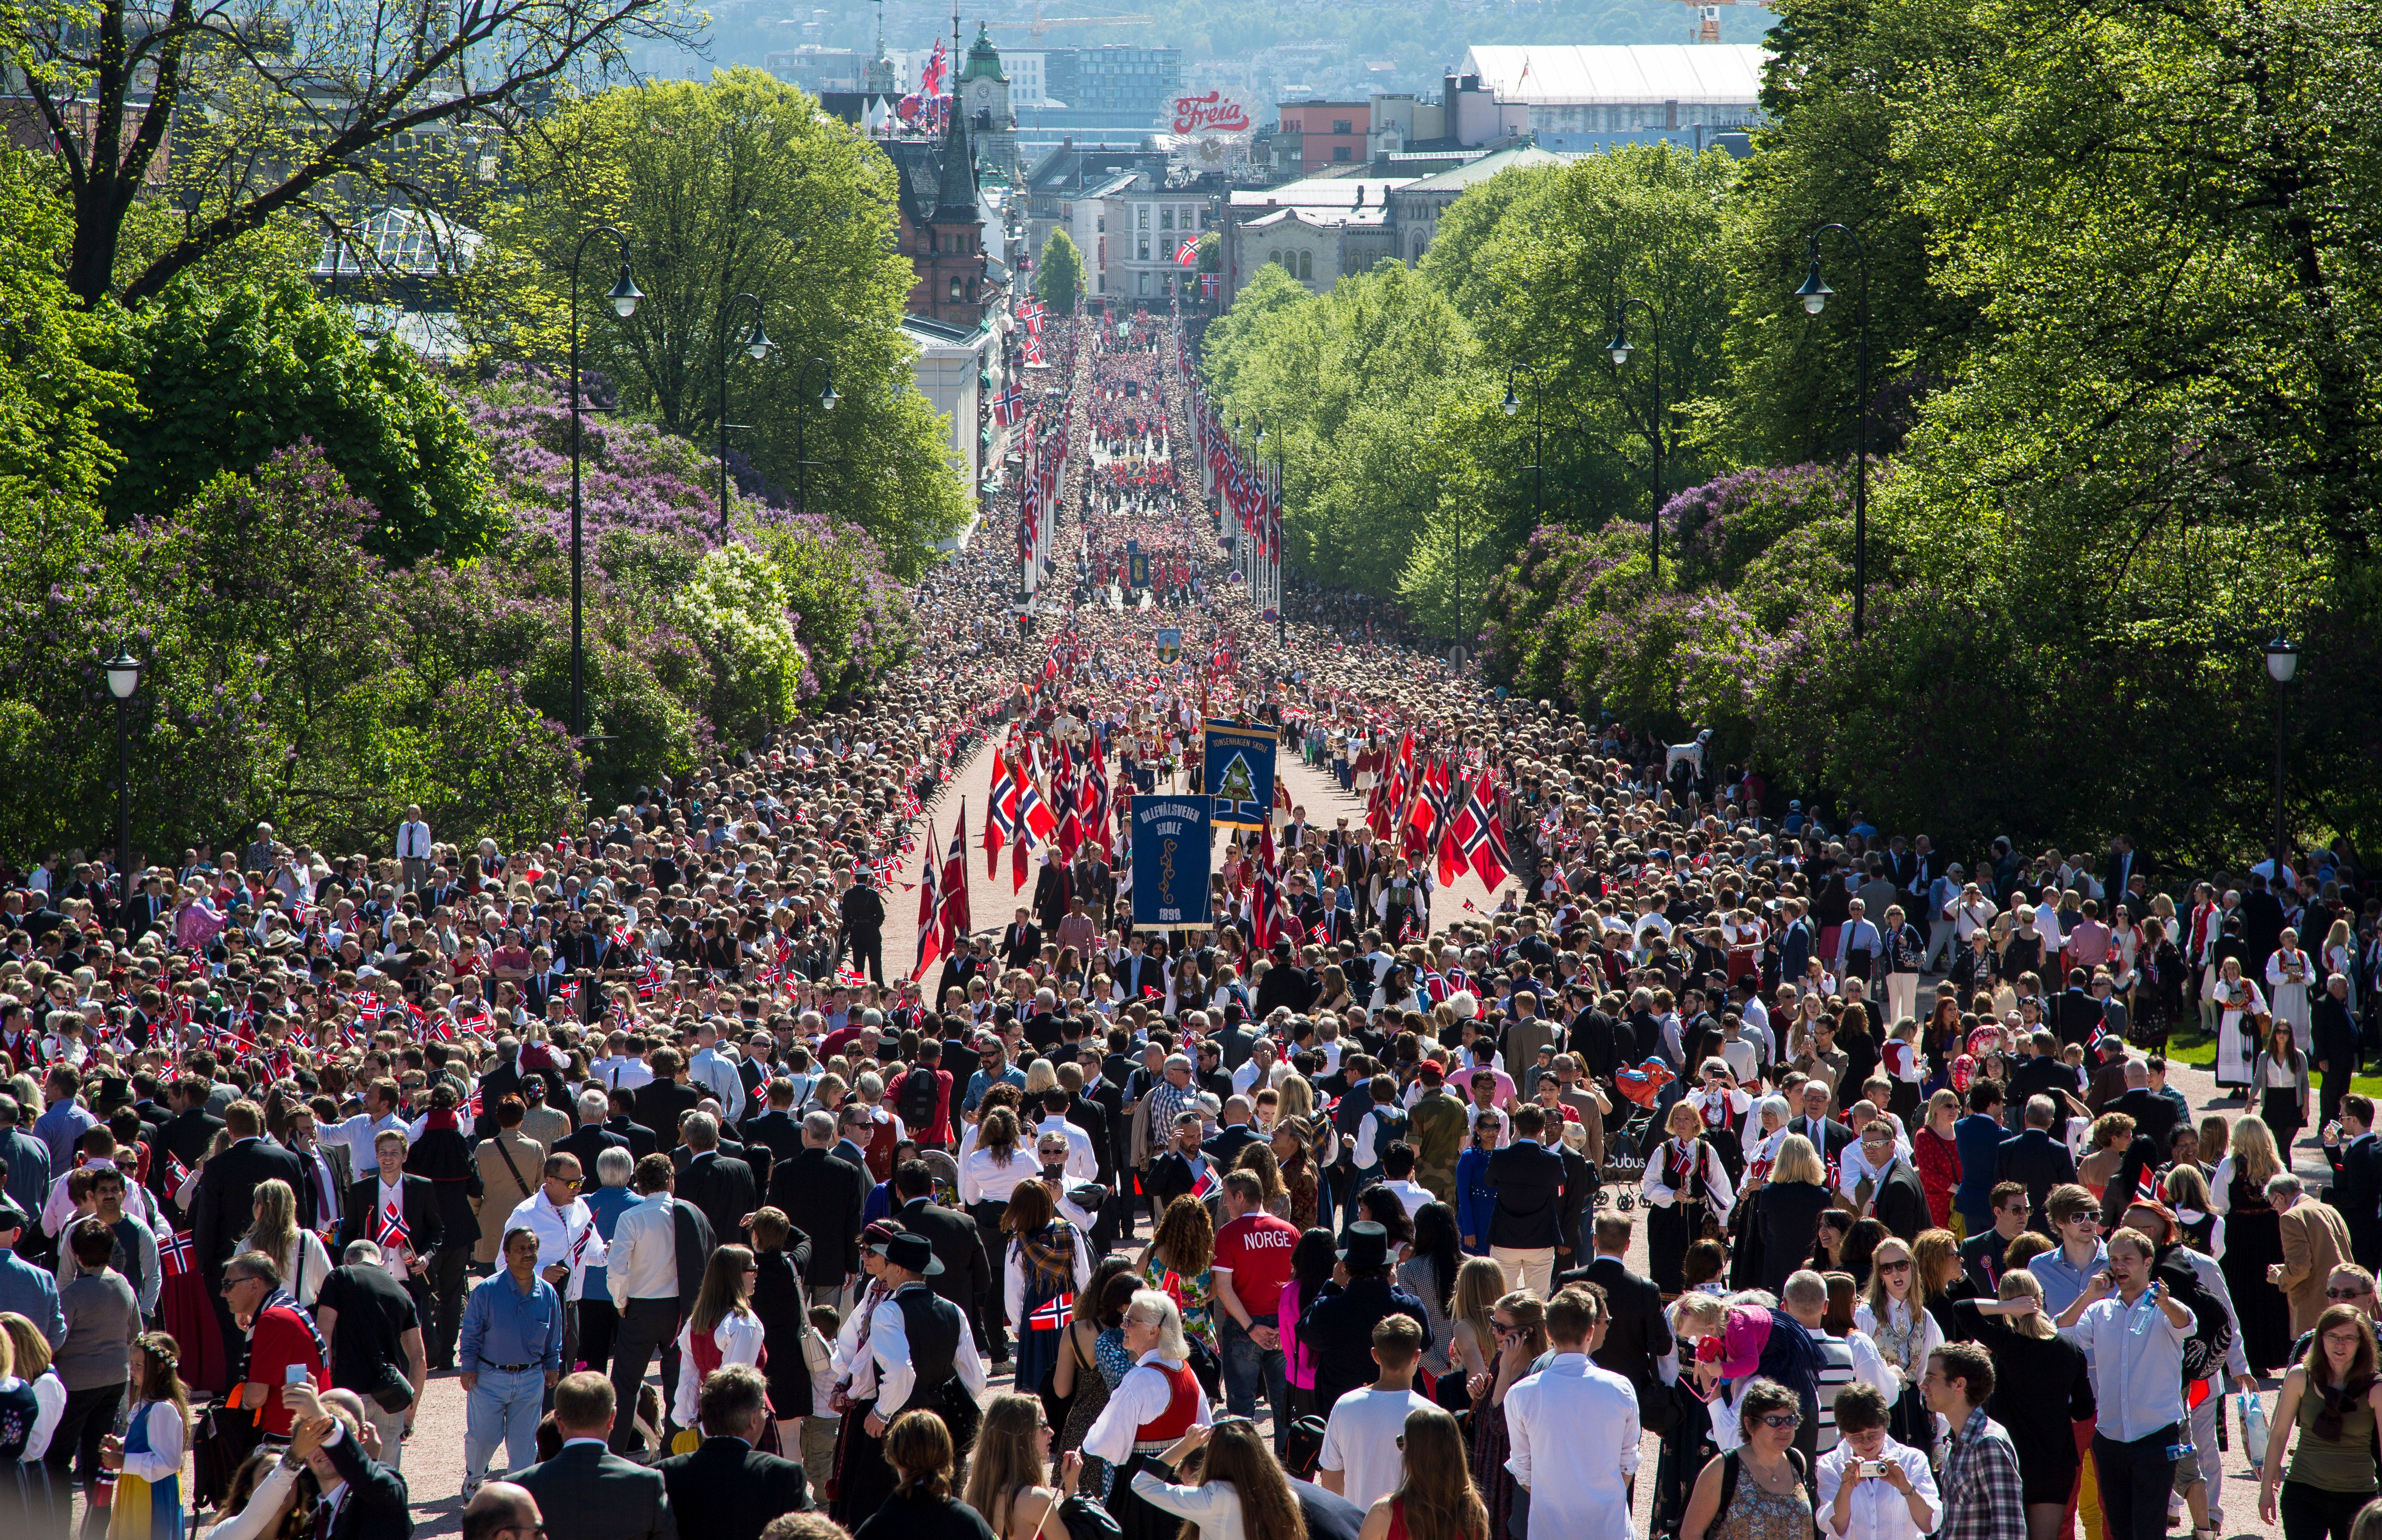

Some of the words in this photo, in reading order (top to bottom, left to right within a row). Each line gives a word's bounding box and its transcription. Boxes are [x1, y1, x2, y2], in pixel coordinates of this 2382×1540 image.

[1174, 91, 1249, 134] Freia
[1213, 738, 1250, 748] TONSENHAGEN
[1252, 741, 1268, 753] SKOLE
[1140, 802, 1200, 824] ULLEVÅLSVEIEN
[1156, 822, 1182, 836] SKOLE
[1159, 908, 1181, 921] 1898
[1244, 1231, 1291, 1250] NORGE
[340, 1498, 351, 1514] EOS
